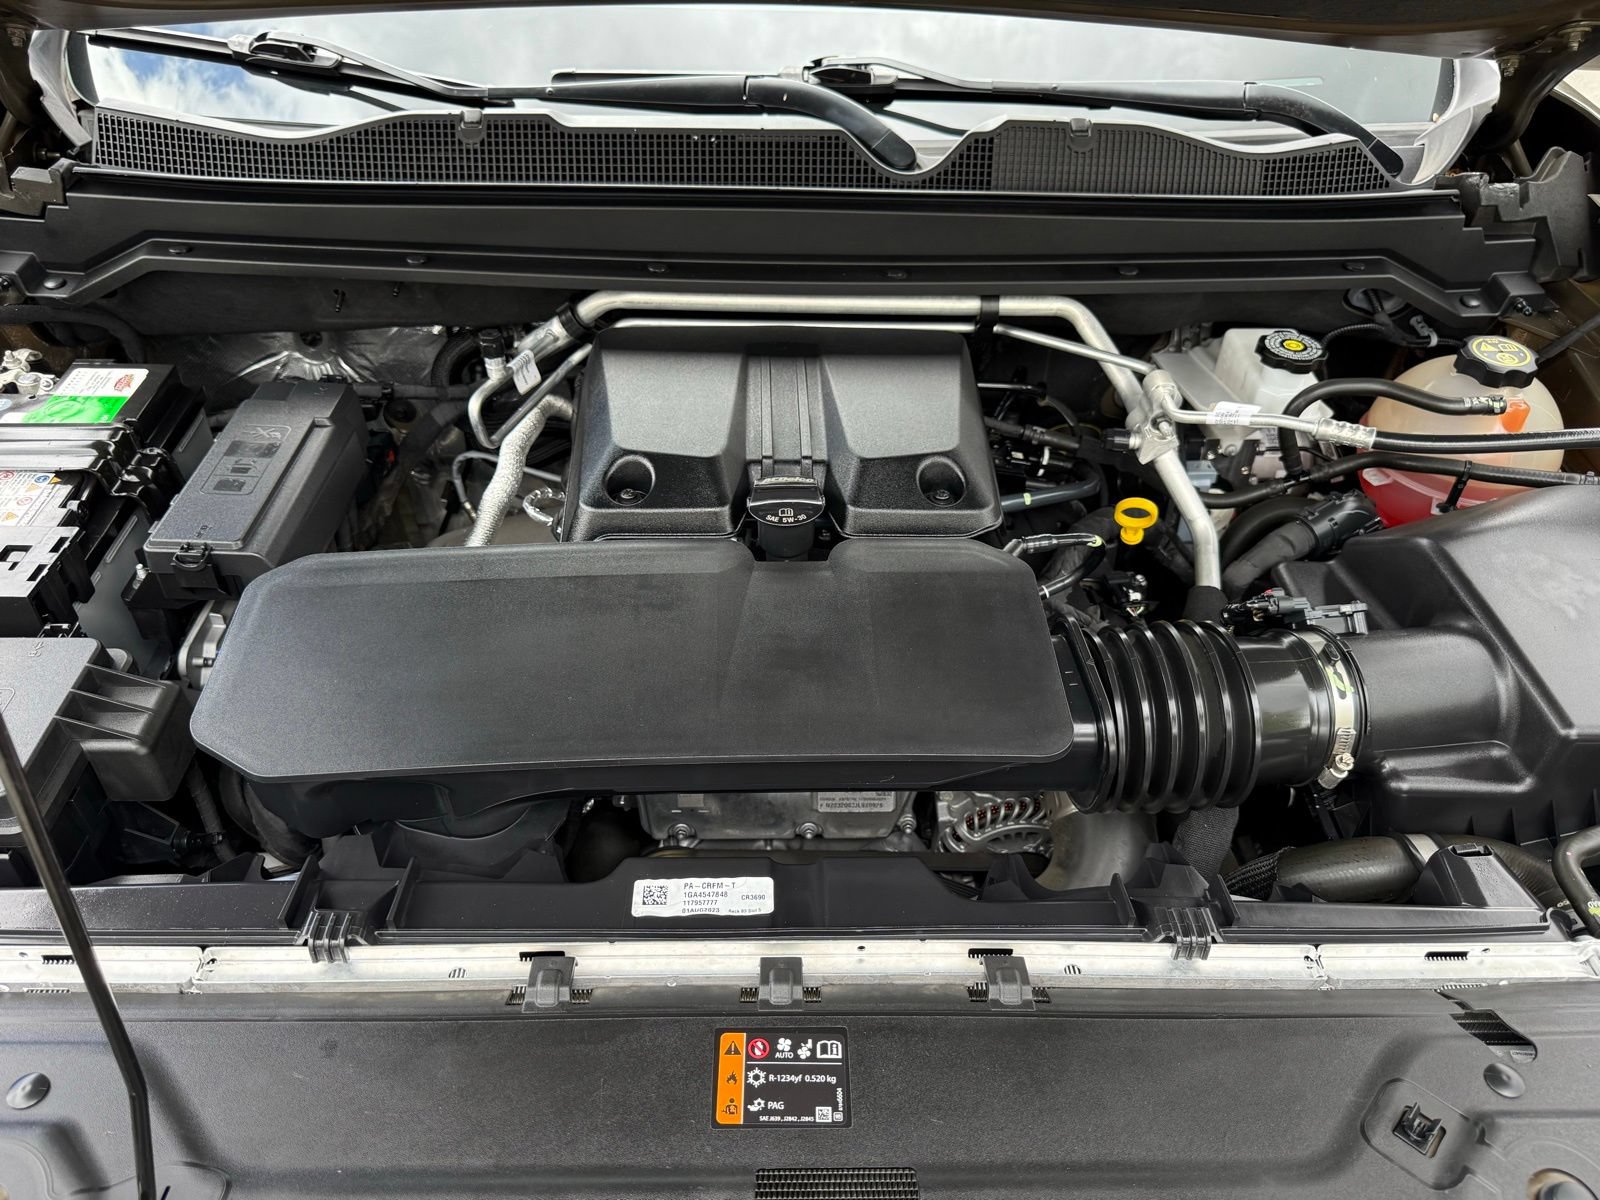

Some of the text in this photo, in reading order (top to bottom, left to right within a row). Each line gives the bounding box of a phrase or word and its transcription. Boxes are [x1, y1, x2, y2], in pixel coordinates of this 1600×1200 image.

[783, 514, 807, 523] 5W-30
[769, 1074, 802, 1083] R-1234yf
[827, 1074, 837, 1084] kg
